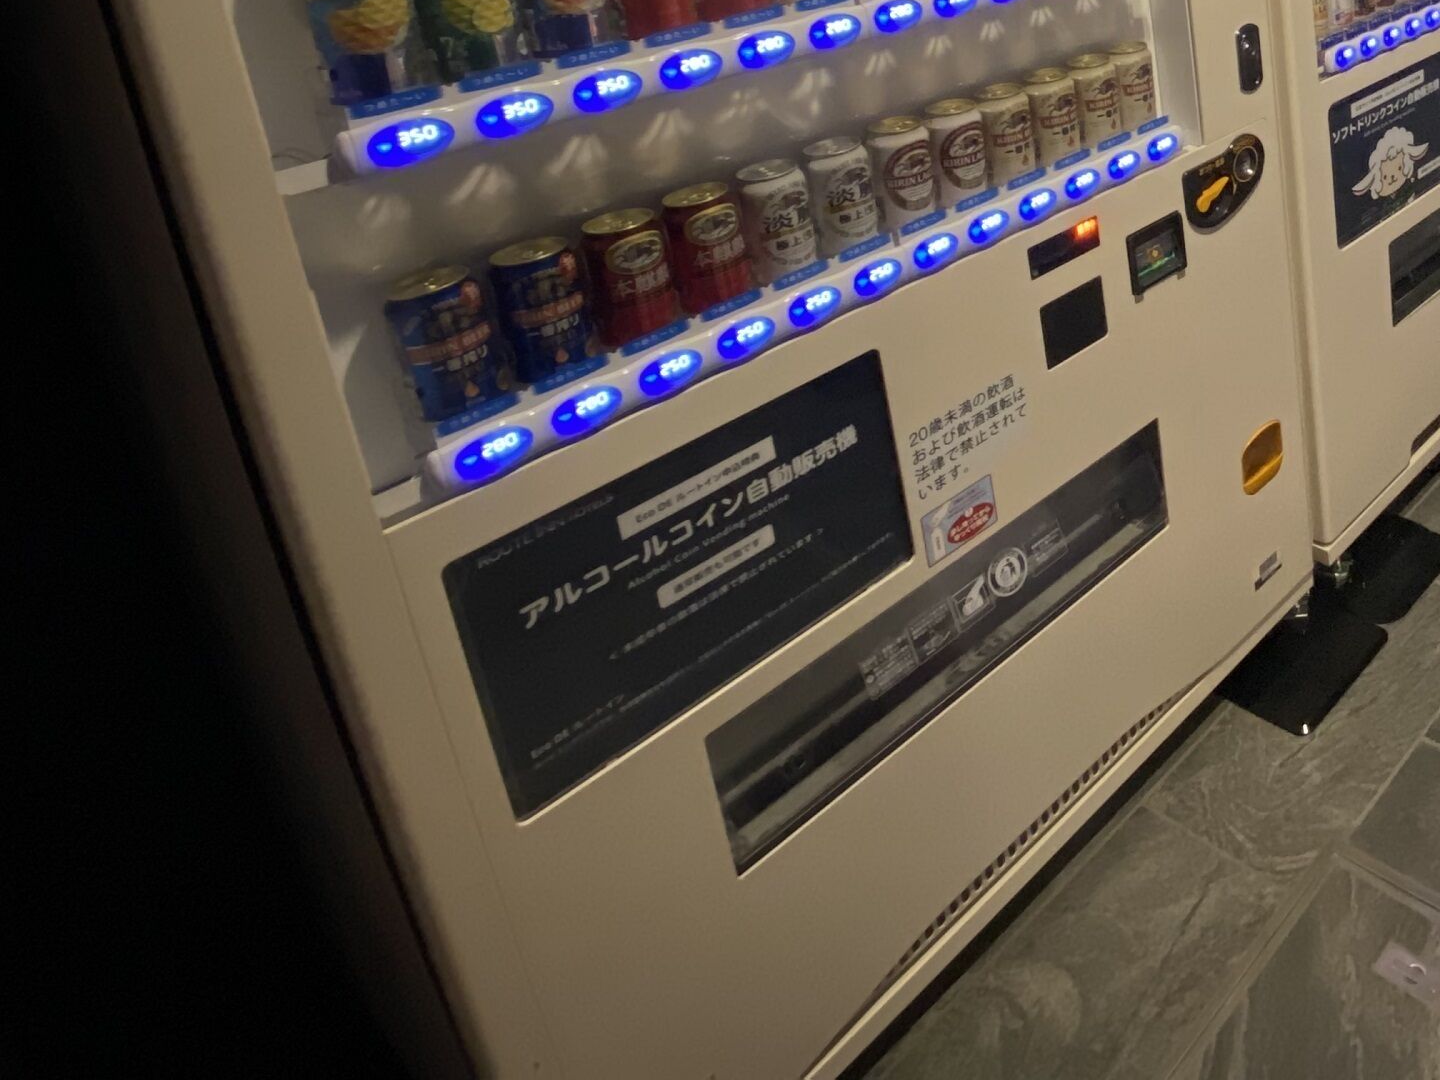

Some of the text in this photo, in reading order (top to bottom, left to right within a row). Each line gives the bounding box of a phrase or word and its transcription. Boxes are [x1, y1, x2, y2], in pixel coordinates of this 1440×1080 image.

[825, 18, 852, 36] 280
[756, 35, 785, 54] 280
[680, 54, 711, 73] 280
[596, 74, 630, 96] 350
[502, 98, 539, 120] 350
[397, 124, 439, 147] 350
[869, 262, 894, 282] 250
[805, 290, 832, 311] 250
[736, 320, 765, 343] 250
[659, 354, 691, 377] 250
[575, 391, 609, 416] 280
[909, 374, 1014, 448] 20歳未満の飲酒
[912, 387, 1026, 466] および飲酒運転は
[481, 432, 519, 458] 280
[915, 403, 1027, 484] 法律で禁止されて
[918, 464, 969, 500] います。
[519, 424, 858, 629] アルコールコイン自動販売機
[635, 509, 656, 524] Eco
[627, 494, 791, 590] Alcohol Coin Vending machine
